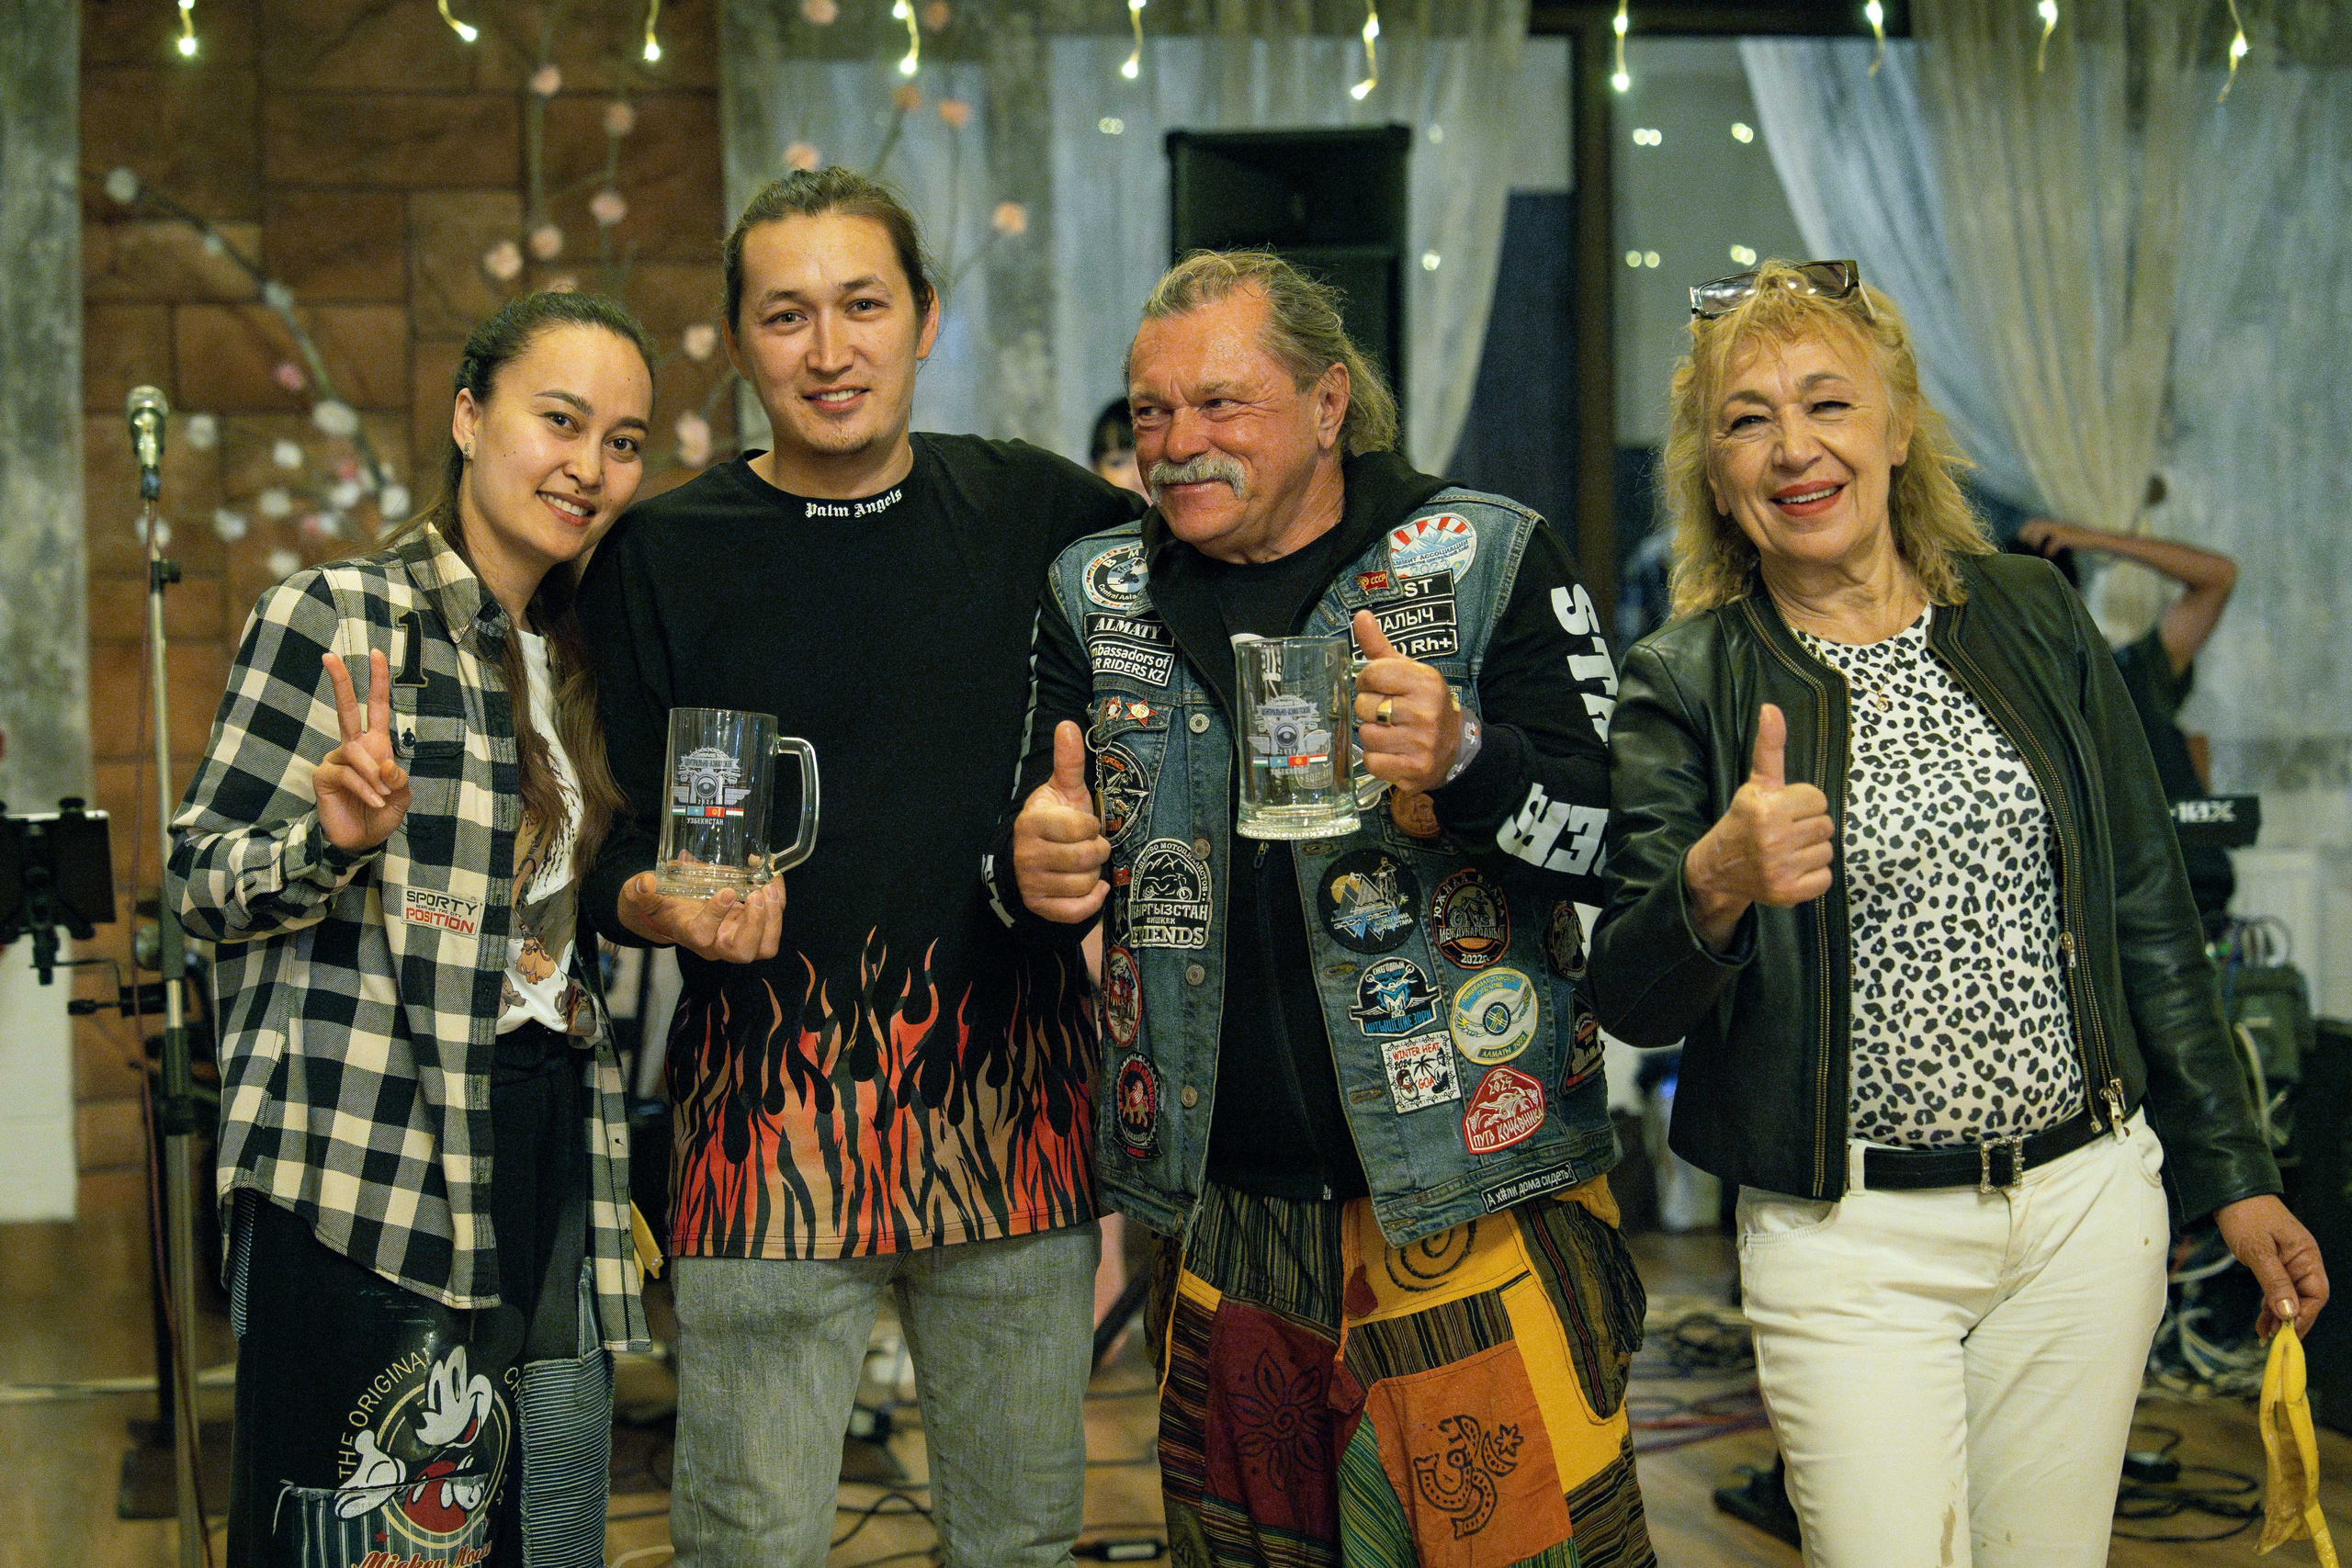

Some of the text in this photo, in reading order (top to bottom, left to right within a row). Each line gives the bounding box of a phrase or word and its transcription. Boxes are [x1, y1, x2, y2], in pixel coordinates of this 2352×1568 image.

[805, 489, 903, 518] Palm Angels
[1420, 539, 1468, 560] АССОЦИАЦИИ
[1098, 584, 1118, 600] Central
[1093, 617, 1162, 639] ALMATY
[1411, 637, 1453, 654] Rh+
[1102, 657, 1148, 677] RIDERS
[1148, 668, 1166, 682] KZ
[1155, 655, 1170, 670] of
[686, 818, 724, 826] УЗБЕКИСТАН
[406, 890, 478, 916] SPORTY
[406, 907, 475, 934] POSITION
[1131, 904, 1209, 921] КЫРГЫЗСТАН
[1439, 927, 1506, 944] МЕЖДУНАРОДНЫЙ
[1373, 961, 1405, 976] ЕЖЕГОДНЫЙ
[1412, 1009, 1432, 1024] ЗОРИ
[1392, 1042, 1440, 1061] WINTER HEAT
[1482, 1046, 1511, 1058] АЛМАТЫ
[1418, 1076, 1435, 1090] GOA
[1473, 1107, 1544, 1147] ПУТЬ КОЧЕВНИКА
[1487, 1192, 1496, 1207] А
[1518, 1178, 1542, 1197] дома
[1541, 1164, 1572, 1187] сидеть?
[338, 1432, 357, 1479] THE
